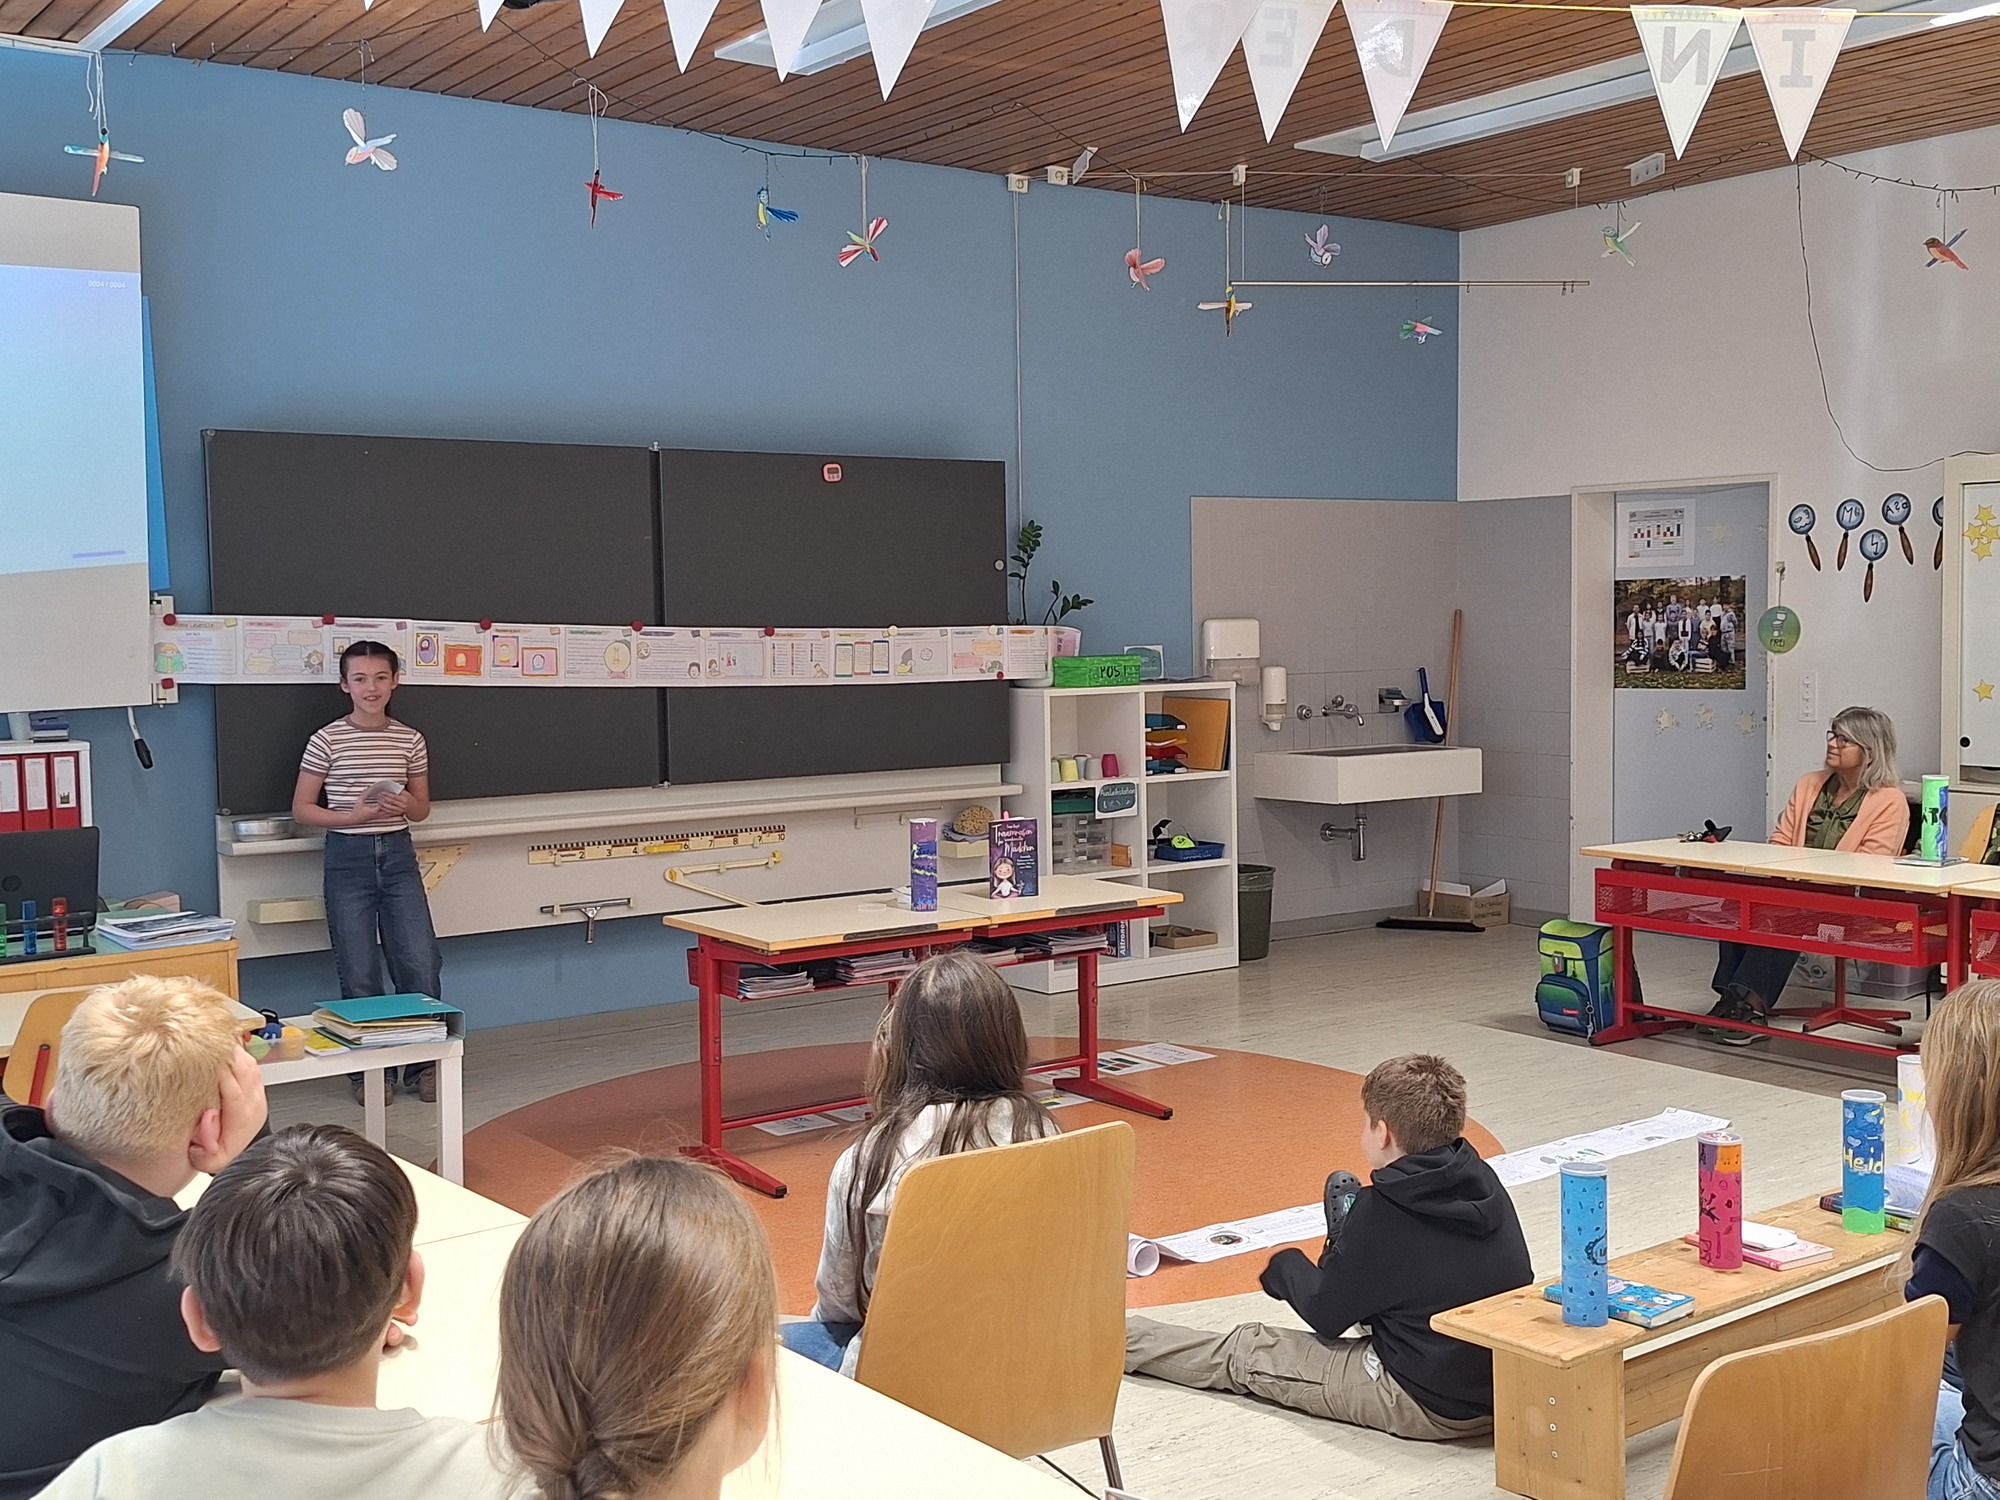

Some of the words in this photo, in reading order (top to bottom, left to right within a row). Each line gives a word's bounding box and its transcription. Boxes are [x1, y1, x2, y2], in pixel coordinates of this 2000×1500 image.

[1100, 665, 1127, 678] POST
[579, 851, 585, 859] 2
[632, 846, 638, 854] 4
[683, 842, 689, 850] 6
[708, 839, 714, 847] 7
[732, 837, 738, 845] 8
[777, 833, 785, 841] 10
